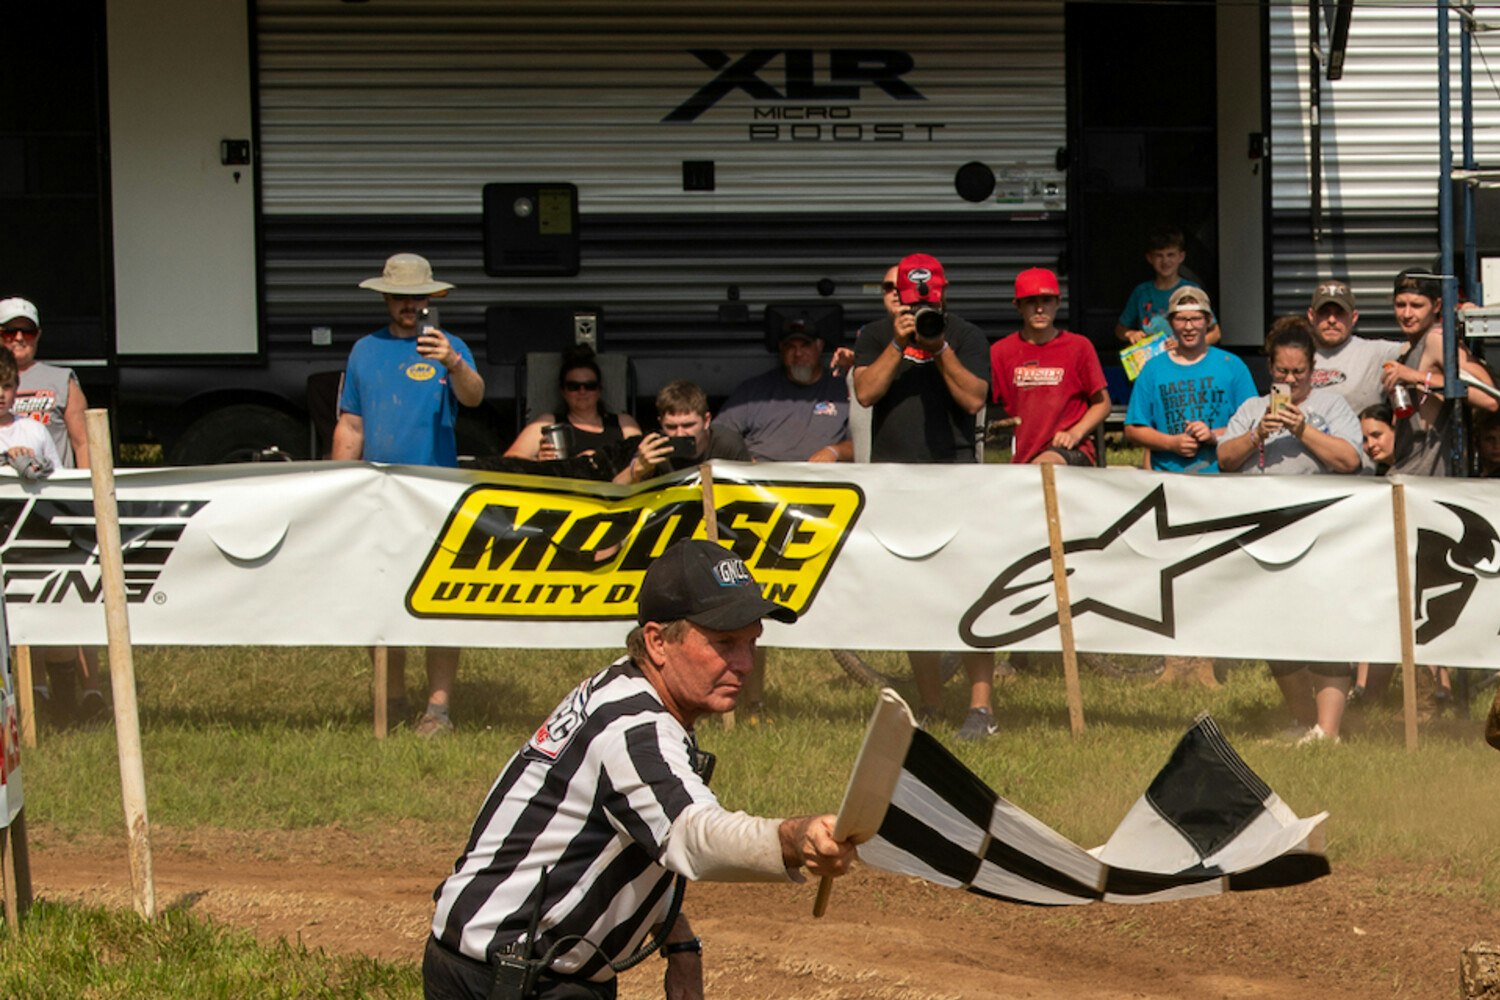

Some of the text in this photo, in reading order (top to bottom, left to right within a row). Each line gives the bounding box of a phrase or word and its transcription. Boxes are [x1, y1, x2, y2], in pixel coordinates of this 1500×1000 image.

[661, 48, 929, 122] XLR
[753, 106, 851, 120] MICRO
[750, 123, 946, 142] BOOST
[1158, 379, 1196, 396] RACE
[1162, 390, 1209, 410] BREAK
[449, 500, 835, 573] MOOSE
[431, 581, 599, 604] UTILITY
